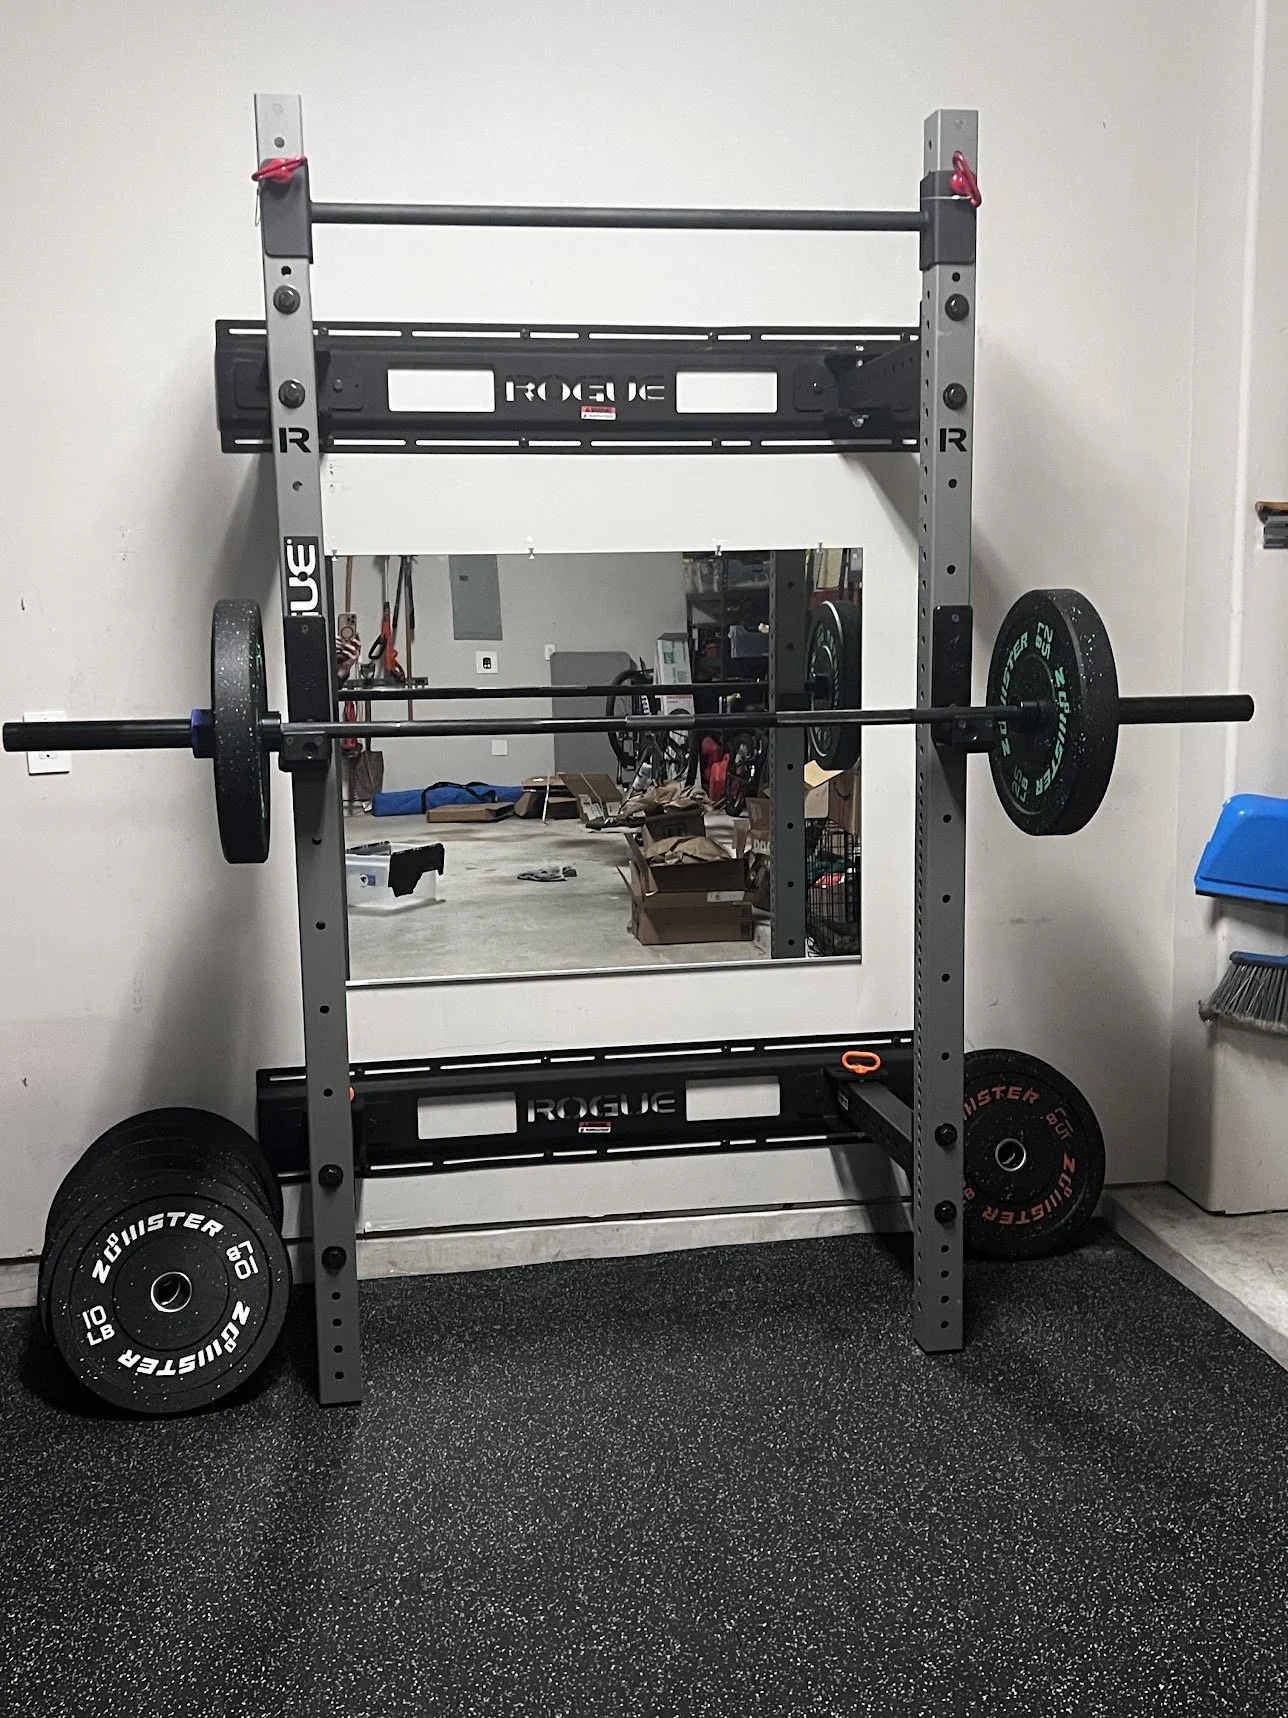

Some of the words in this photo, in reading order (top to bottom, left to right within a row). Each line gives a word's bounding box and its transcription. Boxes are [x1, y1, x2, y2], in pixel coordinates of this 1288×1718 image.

[505, 375, 665, 402] ROGUE
[527, 1091, 675, 1122] ROGUE
[82, 1305, 107, 1330] 10
[86, 1323, 115, 1346] LB
